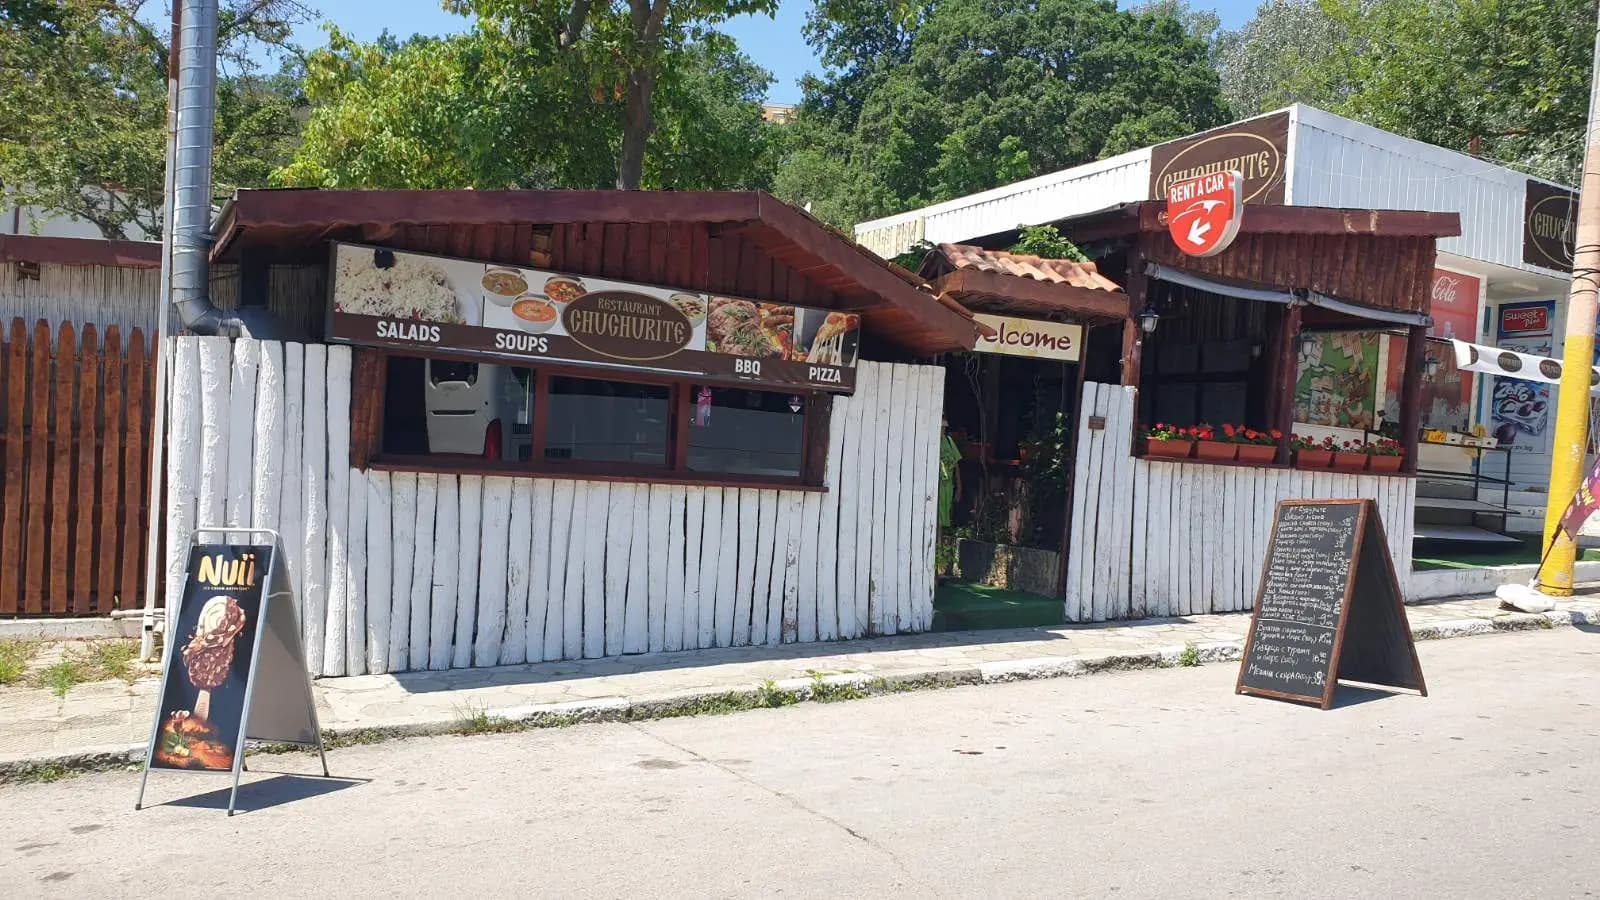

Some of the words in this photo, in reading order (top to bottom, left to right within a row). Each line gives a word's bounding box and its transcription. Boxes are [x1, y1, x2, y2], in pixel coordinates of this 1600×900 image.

[1170, 183, 1196, 204] RENT
[1197, 180, 1204, 197] A
[1205, 174, 1225, 195] CAR
[598, 298, 662, 316] RESTAURANT
[377, 320, 441, 343] SALADS
[570, 309, 685, 344] CHUCHURITE
[495, 332, 548, 353] SOUPS
[735, 358, 761, 376] BBQ
[808, 366, 842, 383] PIZZA
[198, 553, 255, 586] Nuii
